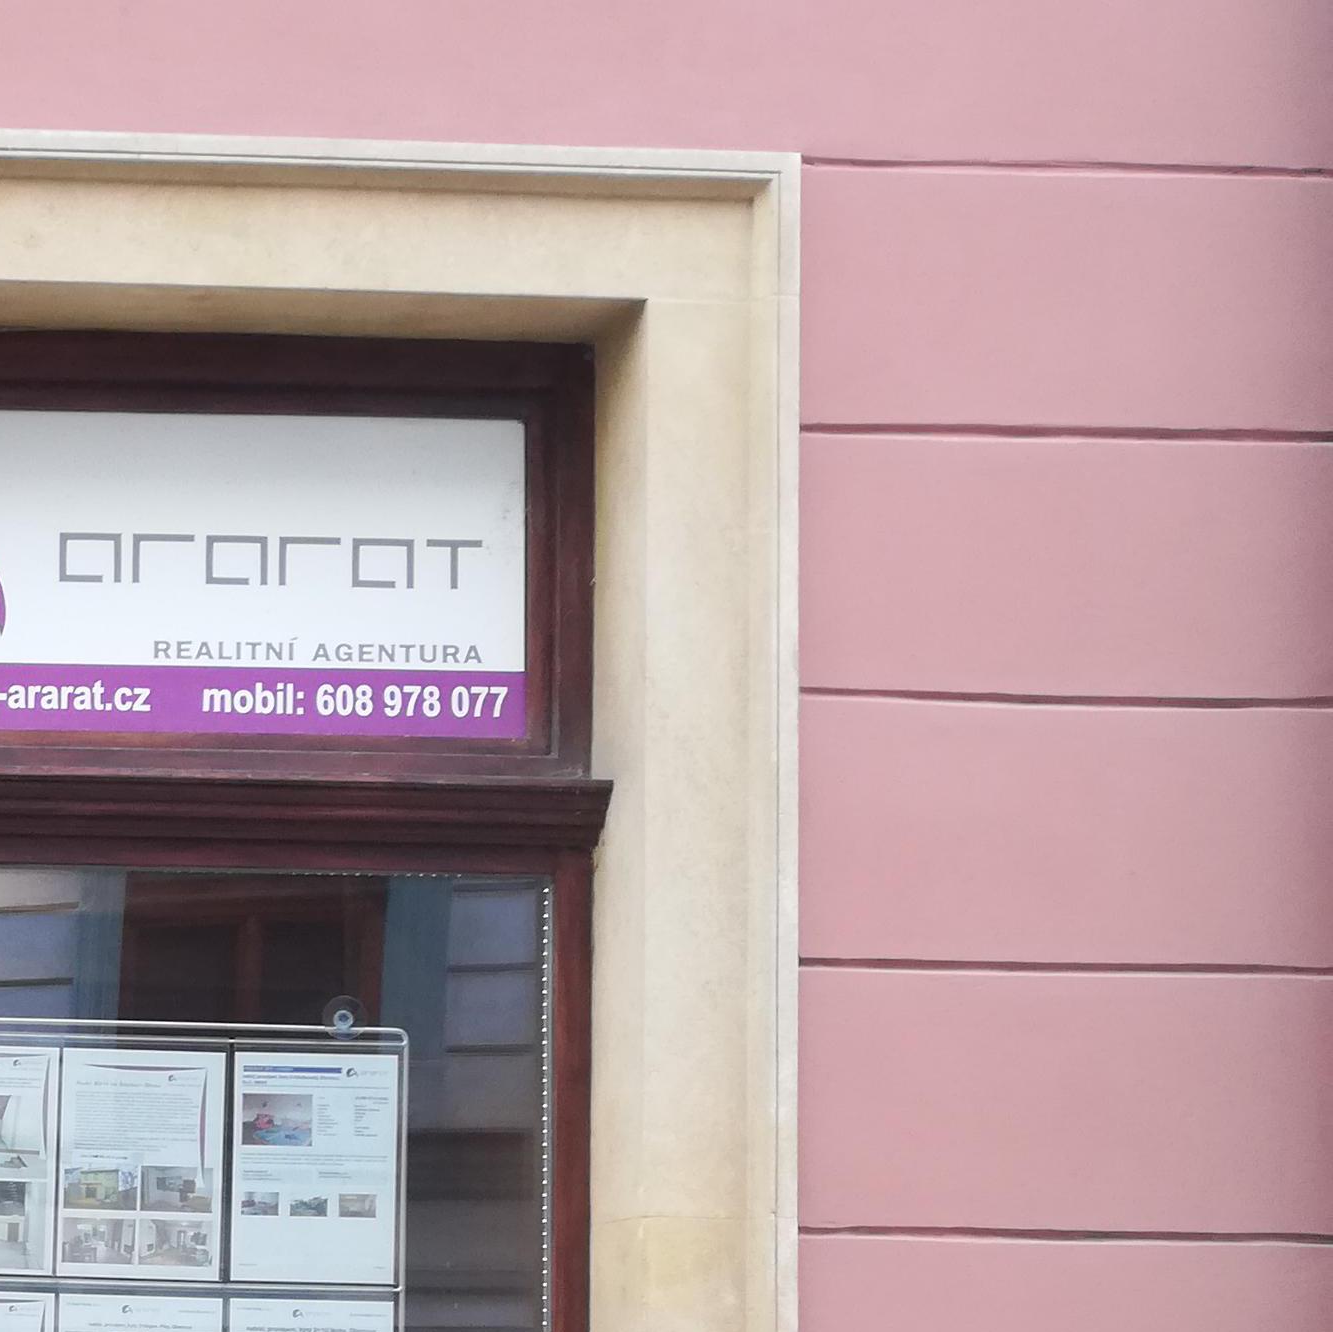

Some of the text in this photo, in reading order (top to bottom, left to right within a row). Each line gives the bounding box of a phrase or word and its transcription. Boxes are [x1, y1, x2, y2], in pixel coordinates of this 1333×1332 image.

[152, 637, 483, 664] REALITNÍ AGENTURA
[201, 682, 306, 716] mobil:
[315, 683, 374, 717] 608
[383, 684, 442, 718] 978
[450, 685, 509, 719] 077
